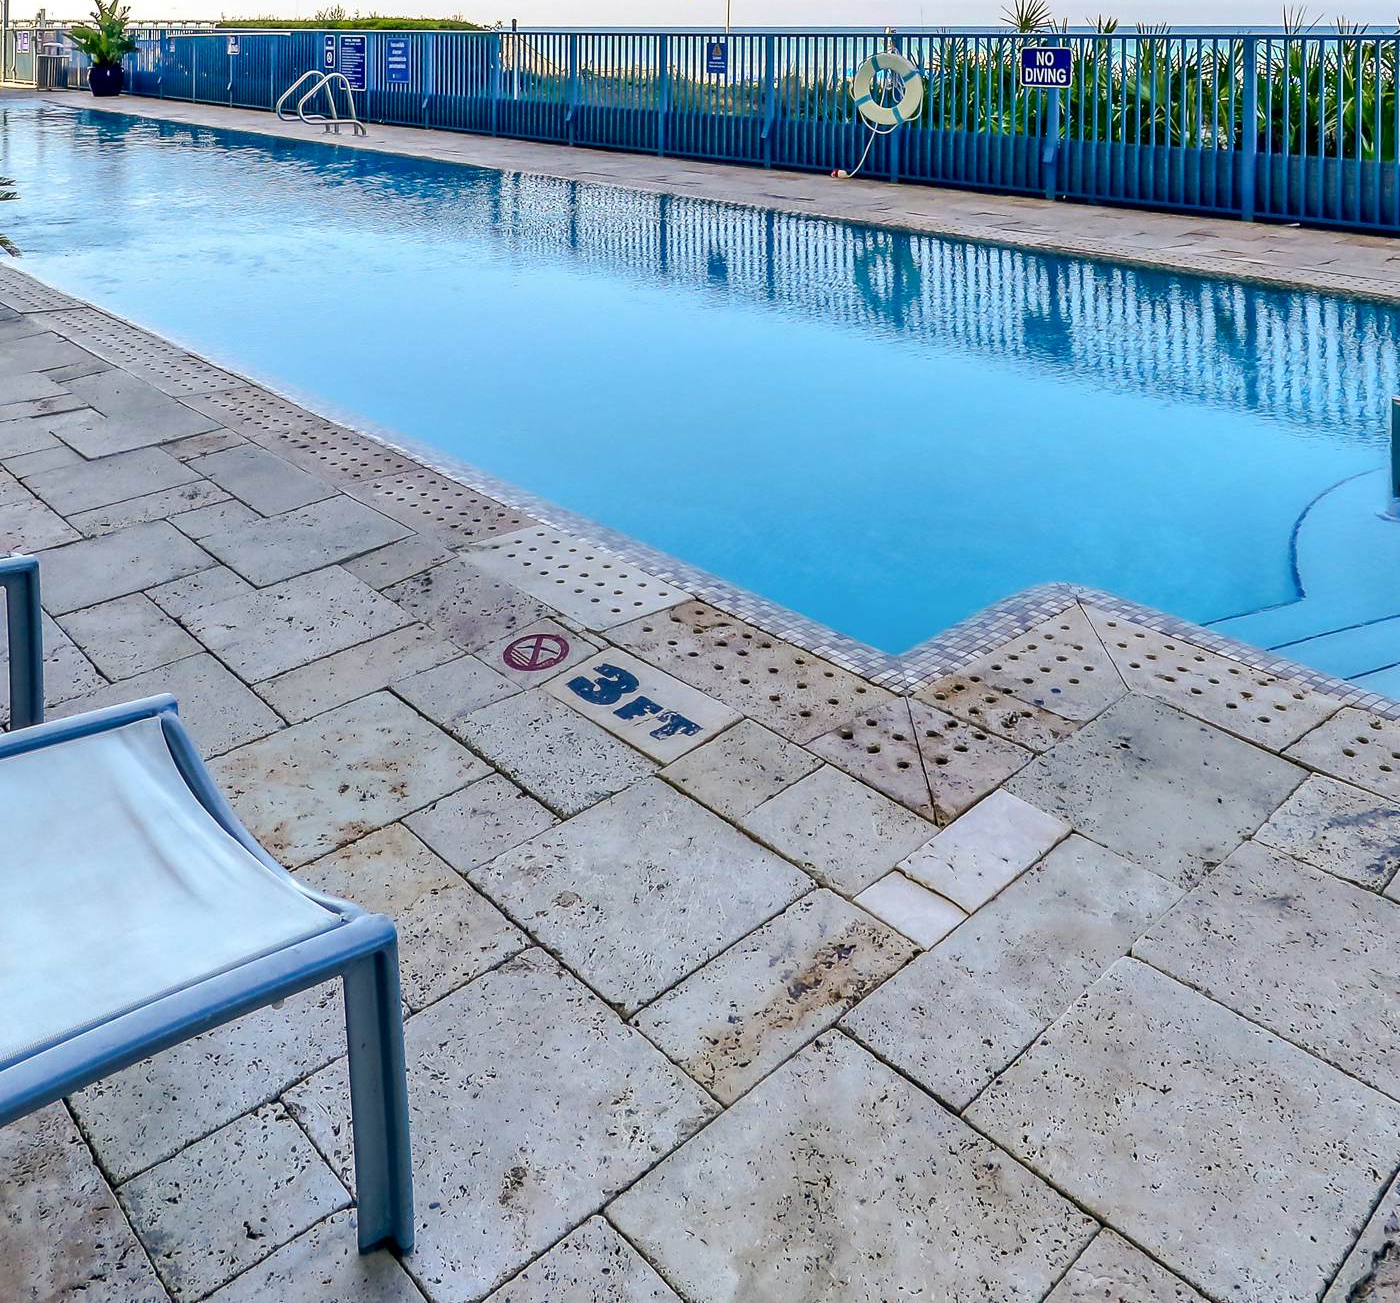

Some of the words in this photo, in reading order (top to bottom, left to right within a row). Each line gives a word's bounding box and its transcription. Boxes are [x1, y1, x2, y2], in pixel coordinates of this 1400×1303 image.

[1036, 51, 1054, 66] NO
[1025, 67, 1067, 84] DIVING
[566, 663, 640, 705] 3
[612, 695, 704, 741] FT
